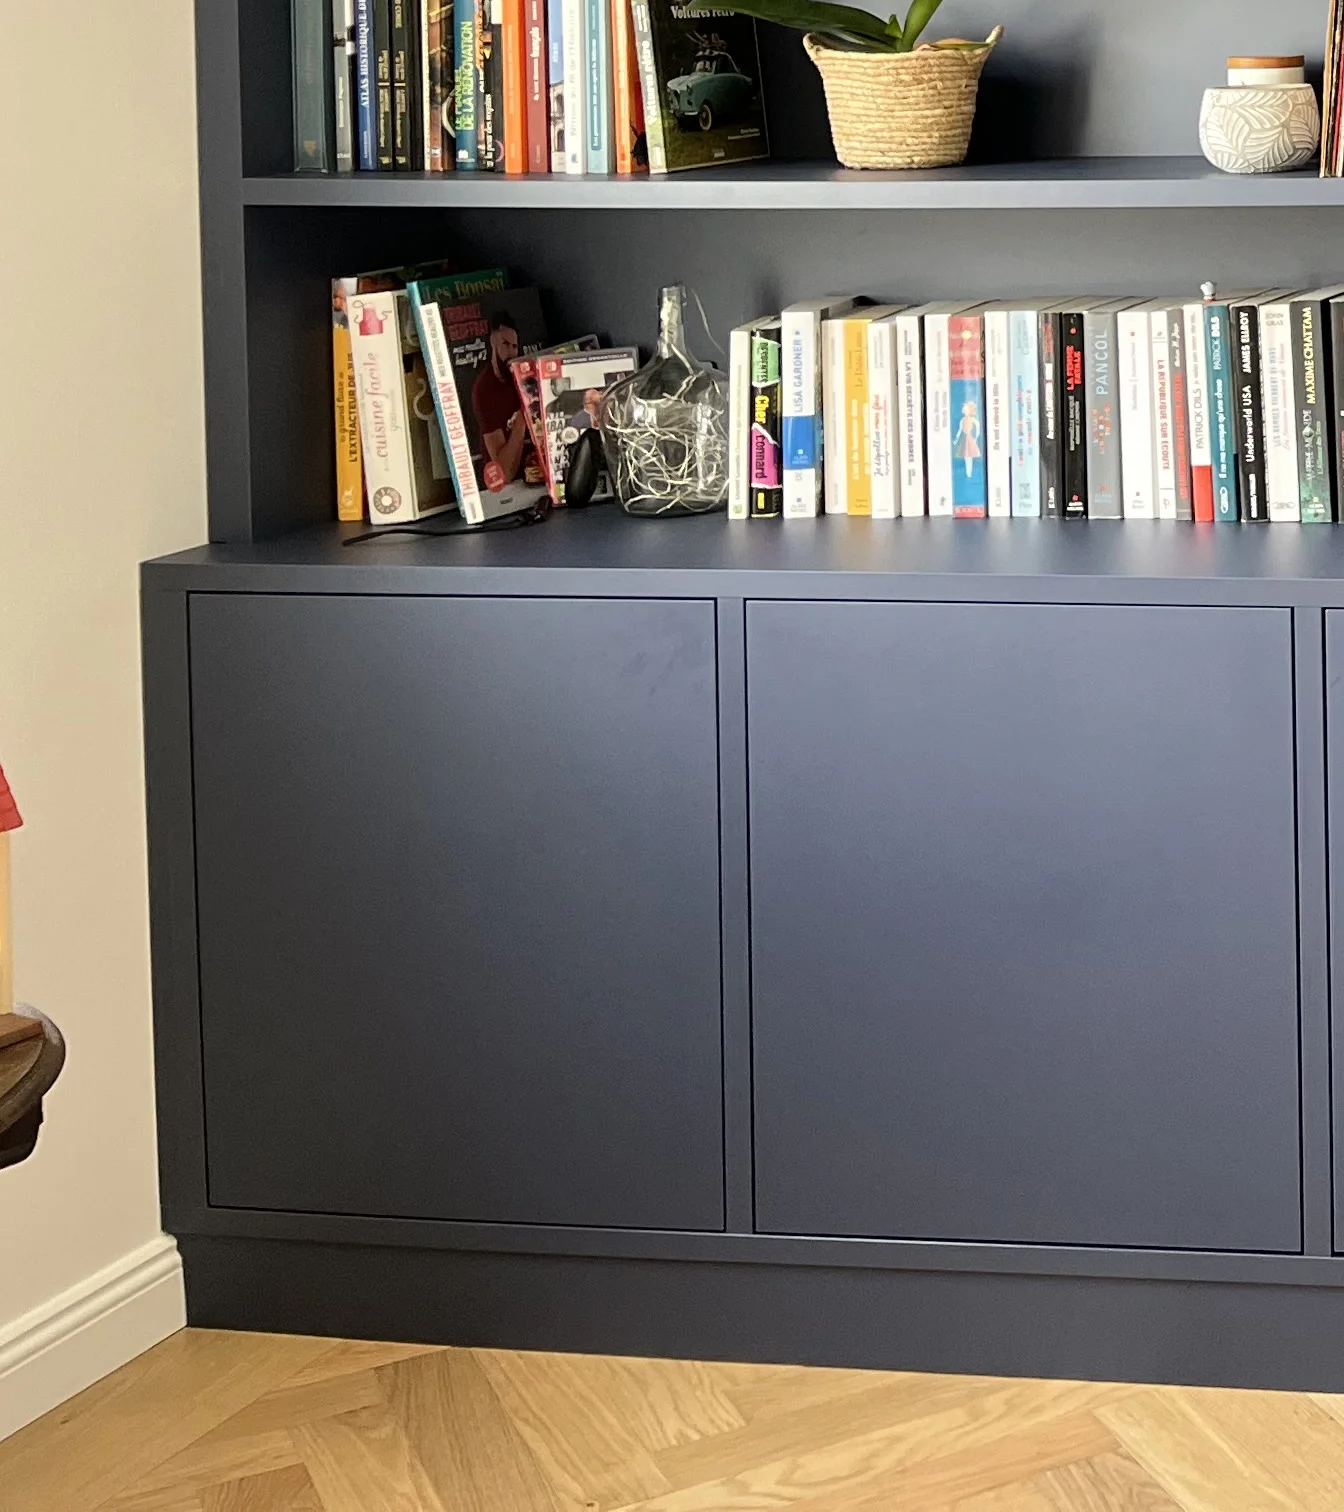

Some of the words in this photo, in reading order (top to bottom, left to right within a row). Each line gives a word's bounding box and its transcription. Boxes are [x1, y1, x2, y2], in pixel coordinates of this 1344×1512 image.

[358, 15, 370, 76] HISTORIQUE
[359, 79, 369, 109] ATLAS
[462, 96, 474, 113] LA
[463, 113, 475, 130] DE
[1240, 312, 1250, 343] ELLROY
[1302, 307, 1314, 360] CHATTAM
[793, 339, 803, 388] GARDNER
[1095, 329, 1109, 395] PANCOL
[1243, 345, 1252, 374] JAMES
[794, 390, 804, 413] LISA
[1243, 385, 1252, 407] USA
[1304, 360, 1316, 404] MAXIME
[347, 389, 359, 463] L'EXTRACTEUR
[373, 400, 389, 458] cuisine
[438, 380, 465, 440] GEOFFRAY
[755, 395, 770, 424] Cher
[1195, 411, 1205, 449] PATRICK
[756, 434, 768, 479] connard
[1244, 408, 1256, 463] Underworld
[455, 443, 476, 498] THIBAULT
